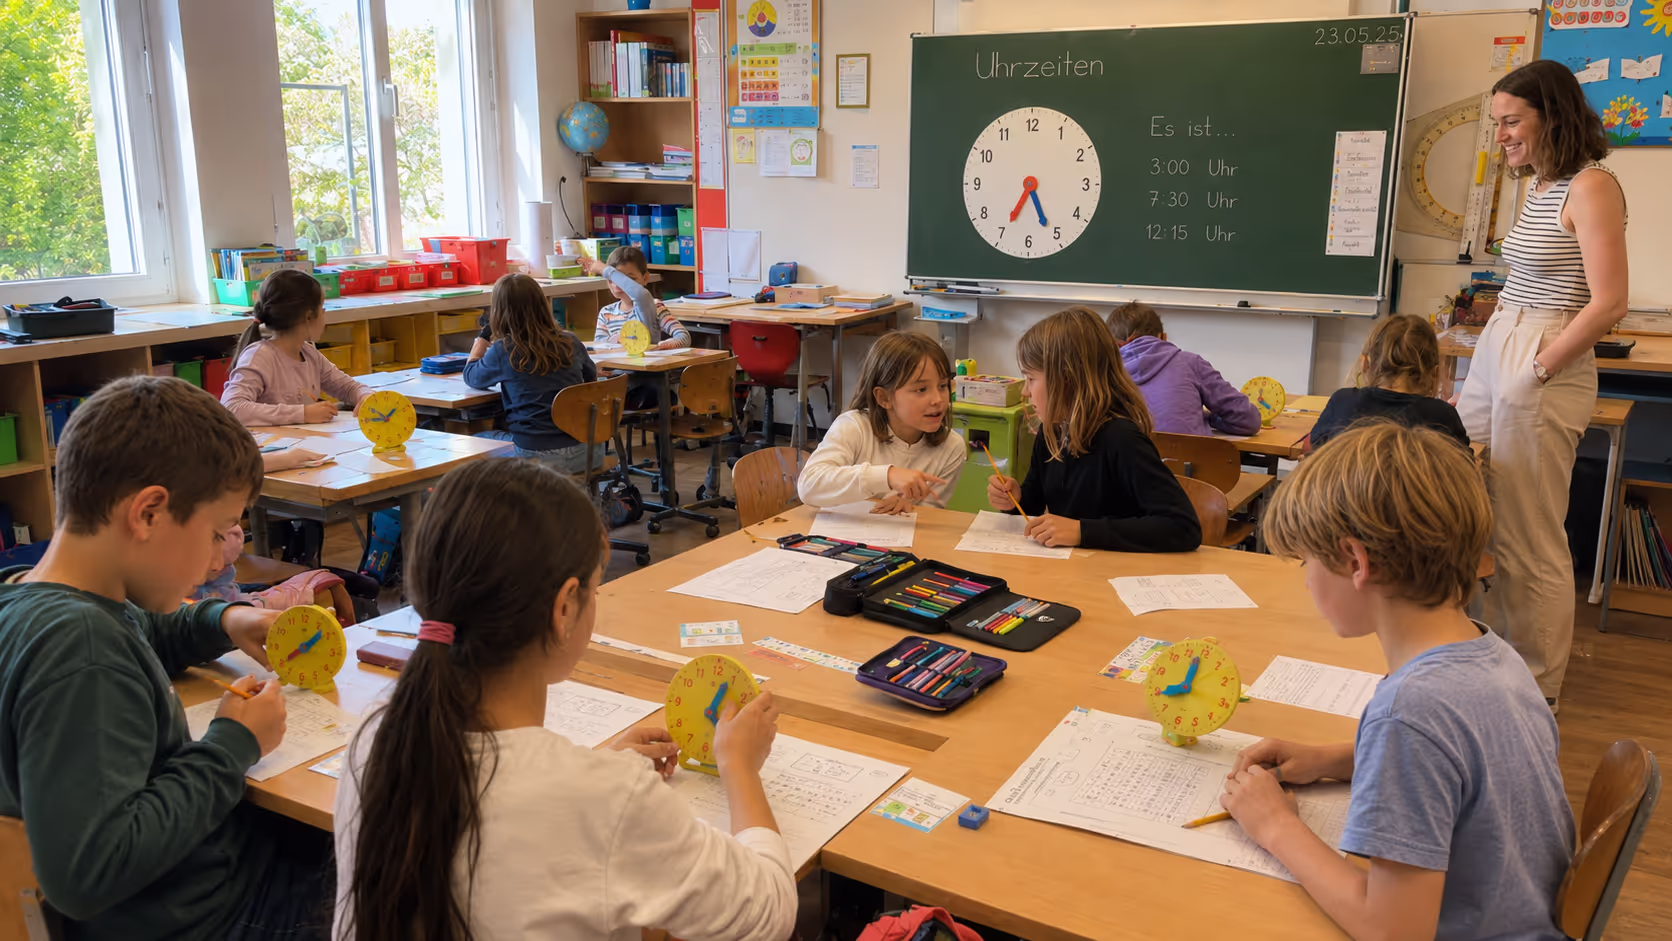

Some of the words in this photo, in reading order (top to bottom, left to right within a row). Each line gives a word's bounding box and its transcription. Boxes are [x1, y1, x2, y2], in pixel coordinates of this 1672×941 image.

[1315, 25, 1400, 45] 23.05.25
[976, 50, 1104, 79] Uhrzeiten
[1026, 118, 1039, 132] 12
[1151, 115, 1175, 137] Es
[999, 128, 1009, 141] 11
[1058, 126, 1063, 140] 1
[980, 150, 993, 163] 10
[1076, 149, 1084, 162] 2
[1150, 158, 1190, 175] 3:00
[1208, 158, 1239, 176] Uhr
[974, 177, 981, 190] 9
[1082, 178, 1090, 191] 3
[1149, 190, 1189, 208] 7:30
[1207, 191, 1239, 209] Uhr
[980, 206, 988, 219] 8
[1072, 206, 1080, 220] 4
[998, 227, 1005, 239] 7
[1053, 227, 1061, 240] 5
[1146, 223, 1188, 240] 12:15
[1206, 224, 1237, 242] Uhr
[1025, 235, 1032, 248] 6
[301, 614, 310, 624] 12
[1169, 651, 1179, 663] 10
[696, 668, 704, 678] 11
[713, 666, 723, 676] 12
[684, 679, 693, 688] 10
[1221, 676, 1228, 687] 2
[675, 697, 681, 706] 9
[740, 693, 747, 704] 2
[1162, 704, 1168, 712] 7
[676, 719, 682, 727] 8
[1175, 716, 1182, 725] 6
[1192, 717, 1199, 727] 5
[688, 734, 694, 743] 7
[703, 742, 709, 752] 6
